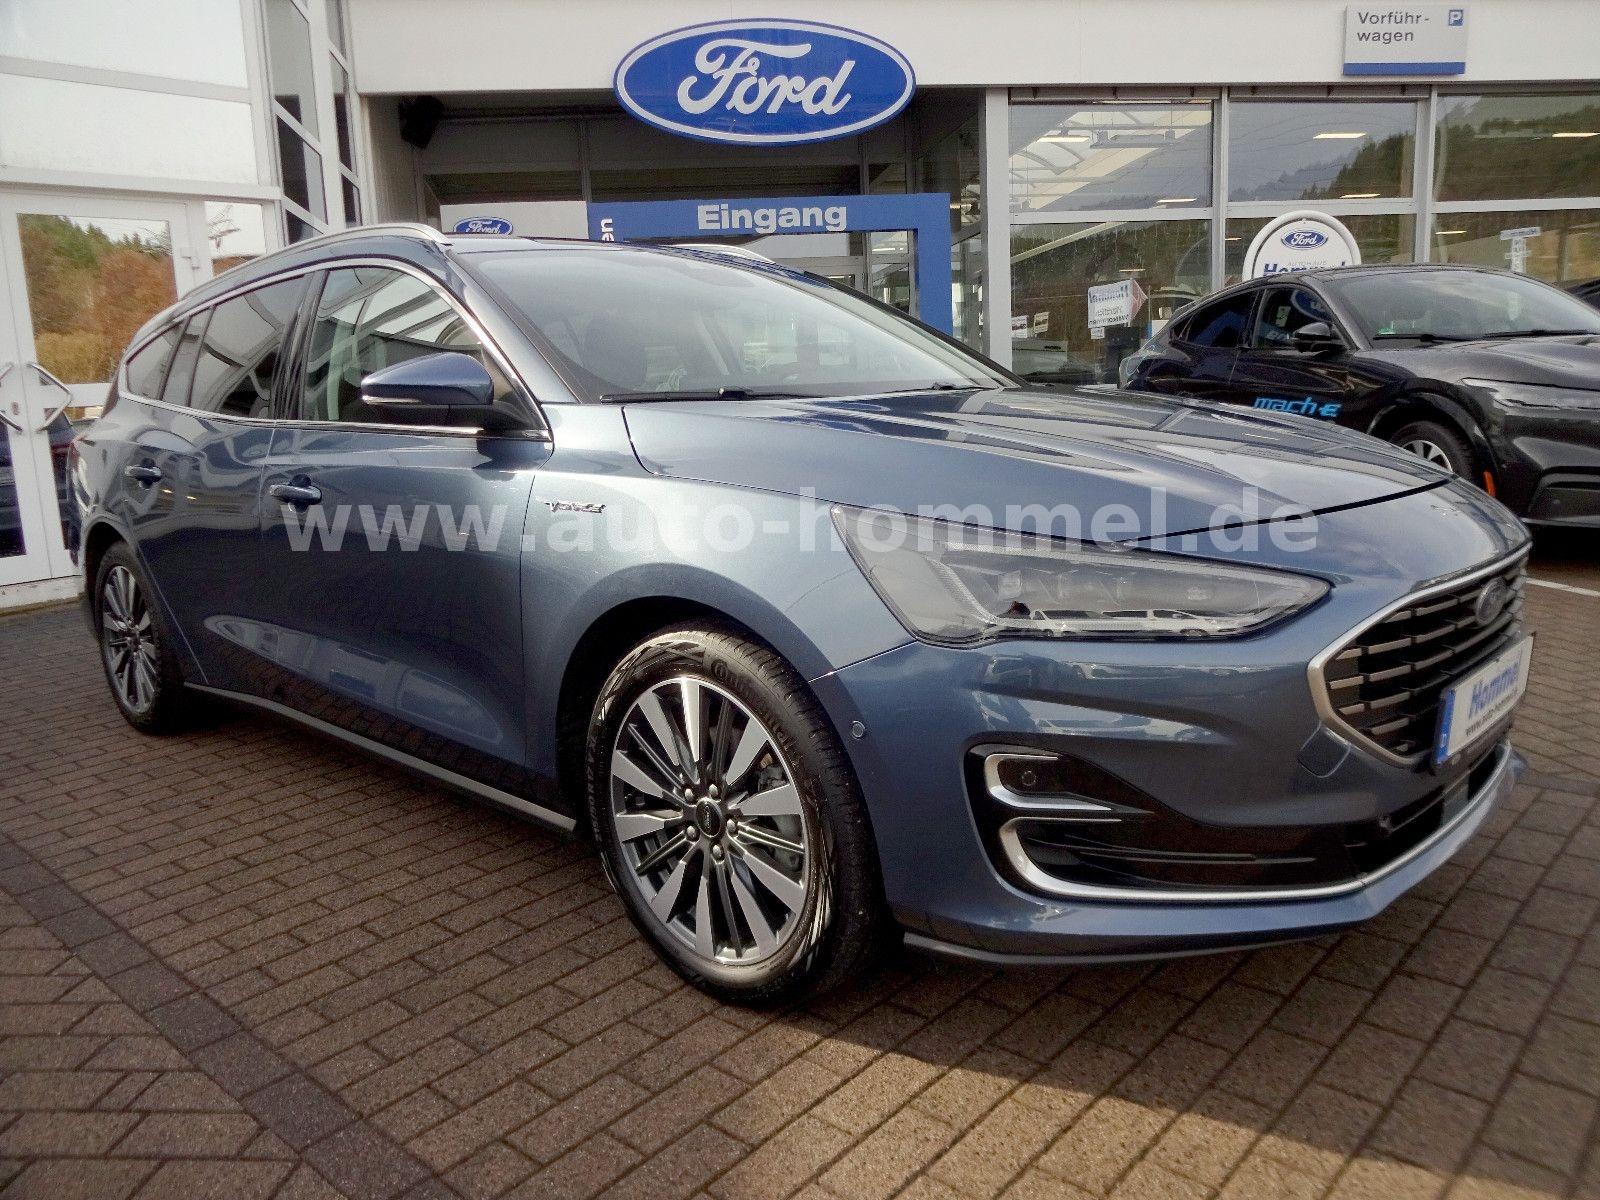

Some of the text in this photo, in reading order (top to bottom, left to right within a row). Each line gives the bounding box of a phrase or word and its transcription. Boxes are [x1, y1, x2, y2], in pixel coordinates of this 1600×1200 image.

[1358, 11, 1430, 25] Vorführ-
[1357, 31, 1414, 45] wagen
[678, 38, 856, 115] Ford
[697, 203, 847, 234] Eingang
[1290, 231, 1319, 246] Ford
